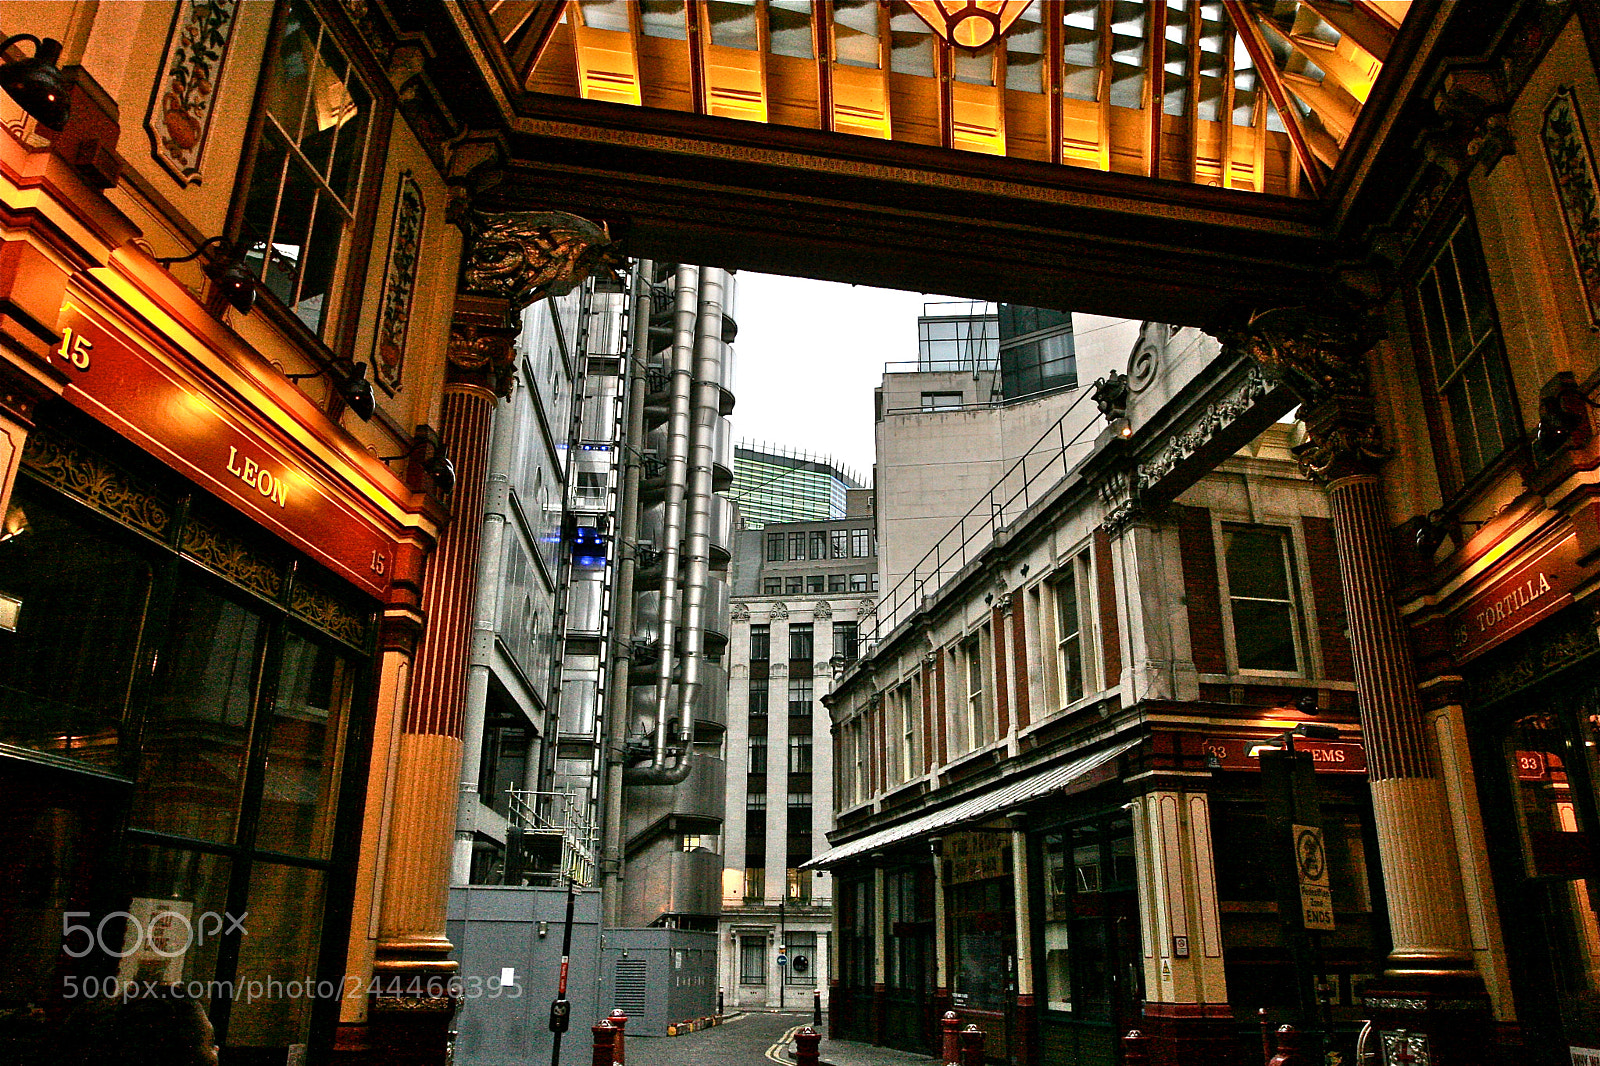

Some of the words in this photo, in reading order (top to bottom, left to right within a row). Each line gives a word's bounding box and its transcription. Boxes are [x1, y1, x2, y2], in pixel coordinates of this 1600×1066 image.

[57, 327, 93, 371] 15
[226, 445, 289, 508] LEON
[370, 549, 385, 575] 15
[1477, 572, 1551, 632] TORTILLA
[1208, 745, 1227, 759] 33
[1521, 757, 1538, 770] 33
[1306, 909, 1330, 924] ENDS
